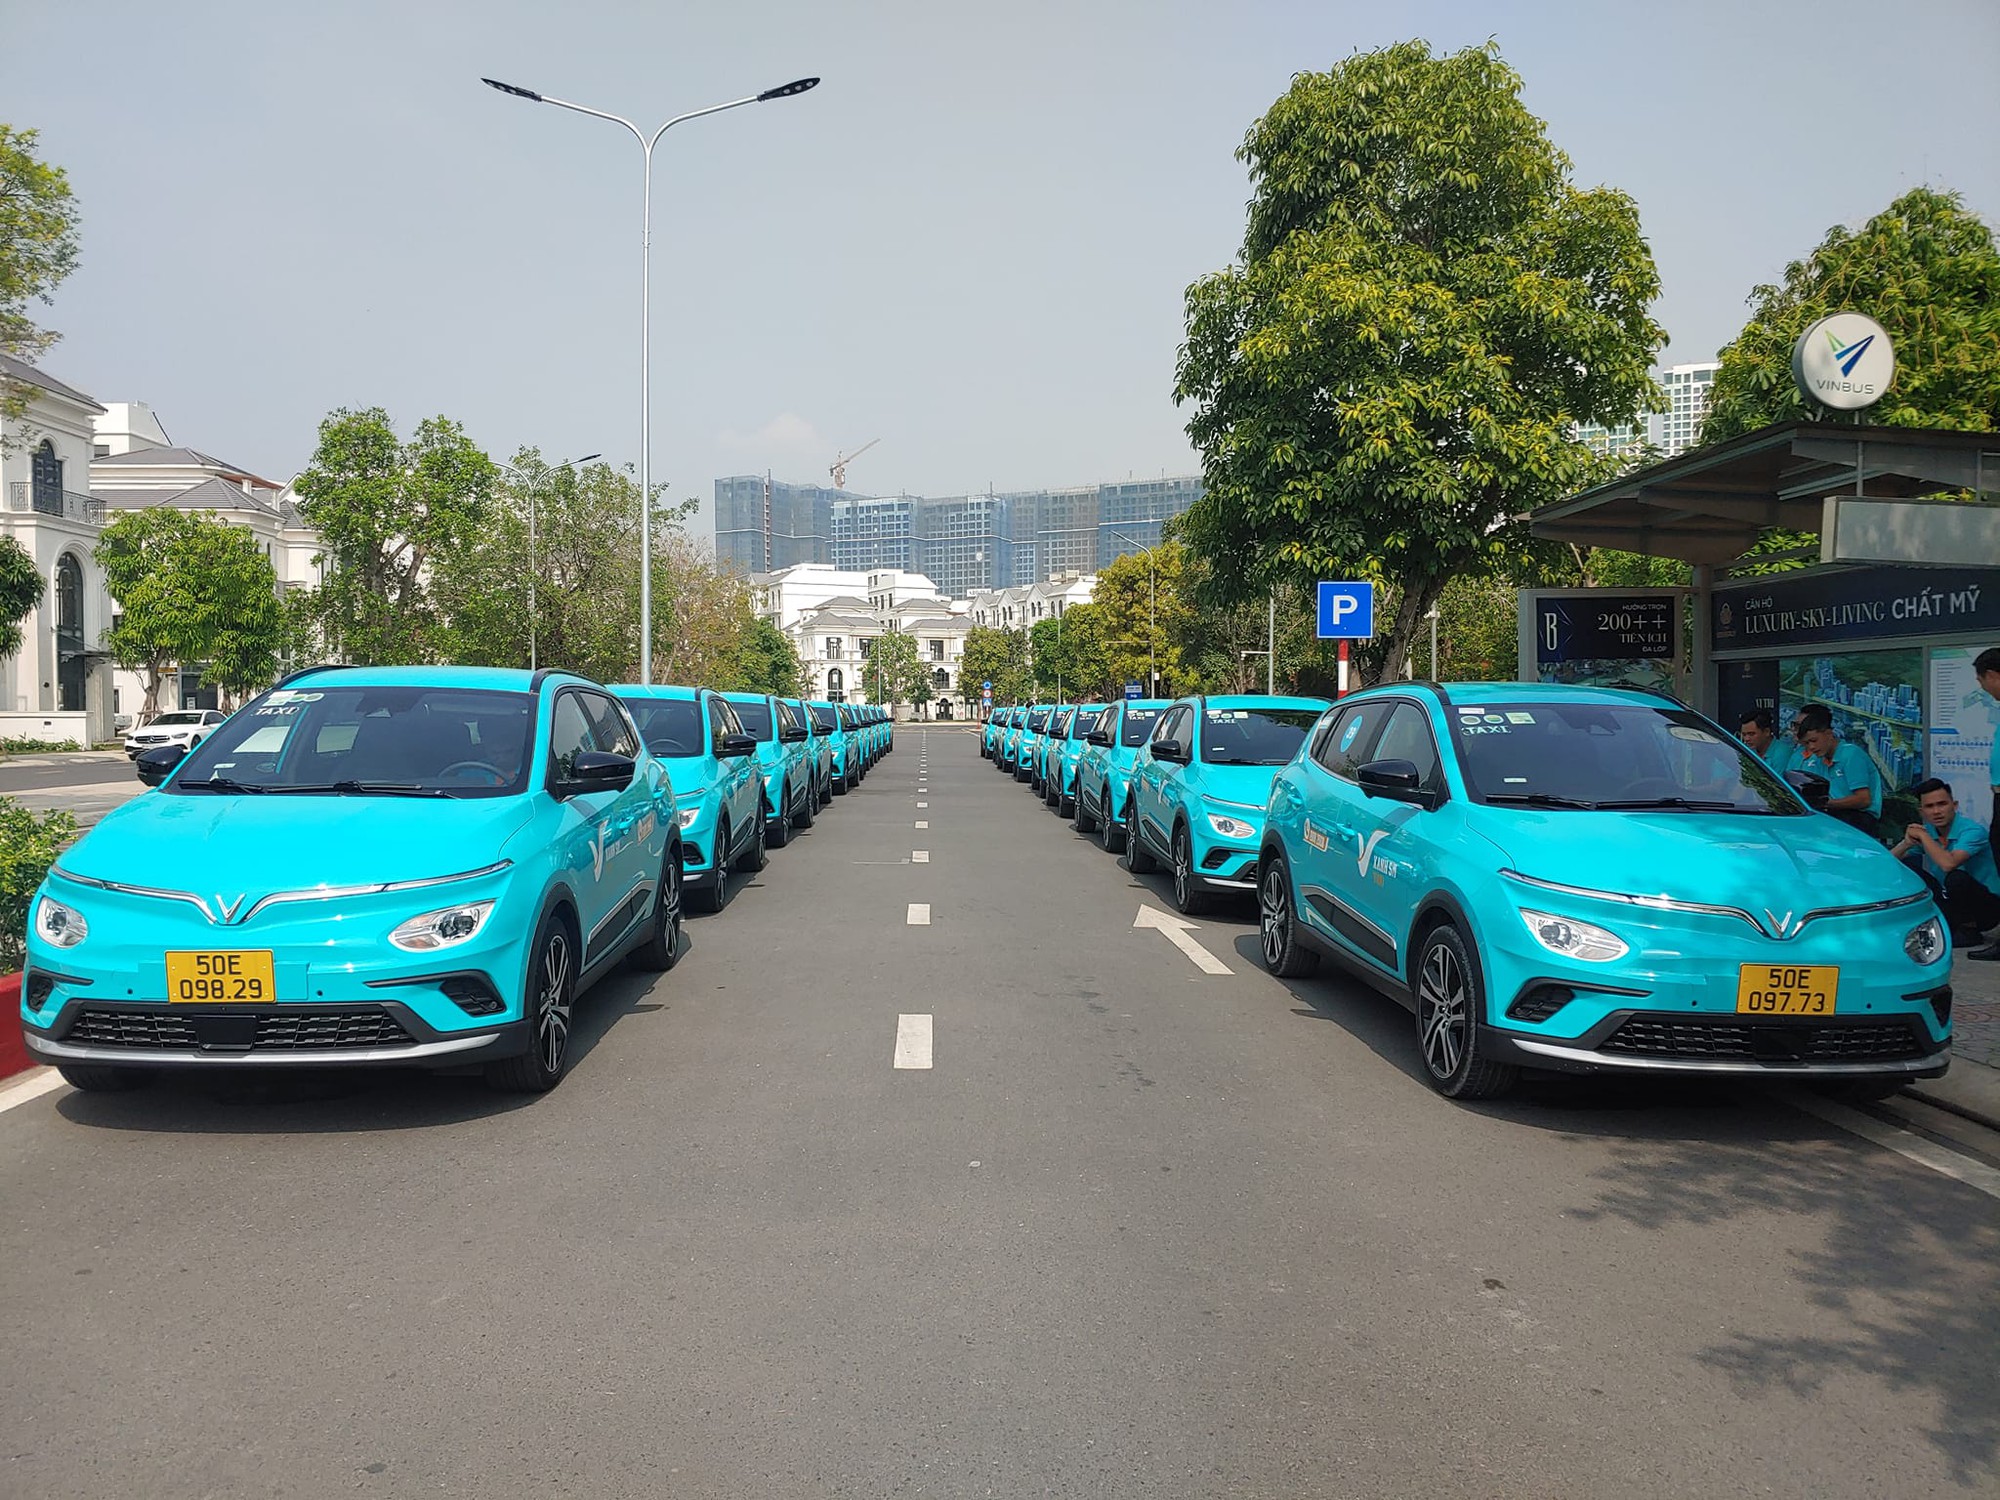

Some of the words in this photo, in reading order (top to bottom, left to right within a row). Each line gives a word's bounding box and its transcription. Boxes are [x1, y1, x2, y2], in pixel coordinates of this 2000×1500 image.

[1816, 379, 1875, 395] VINBUS
[1332, 594, 1358, 625] P
[1745, 601, 1885, 634] LUXURY-SKY-LIVING
[1891, 586, 1944, 620] CHẤT
[1950, 585, 1981, 614] MỸ
[254, 706, 296, 716] TAXI
[1465, 725, 1509, 735] TAXI
[196, 955, 242, 976] 50E
[180, 978, 263, 1000] 098.29
[1768, 968, 1812, 989] 50E
[1748, 991, 1826, 1012] 097.73
